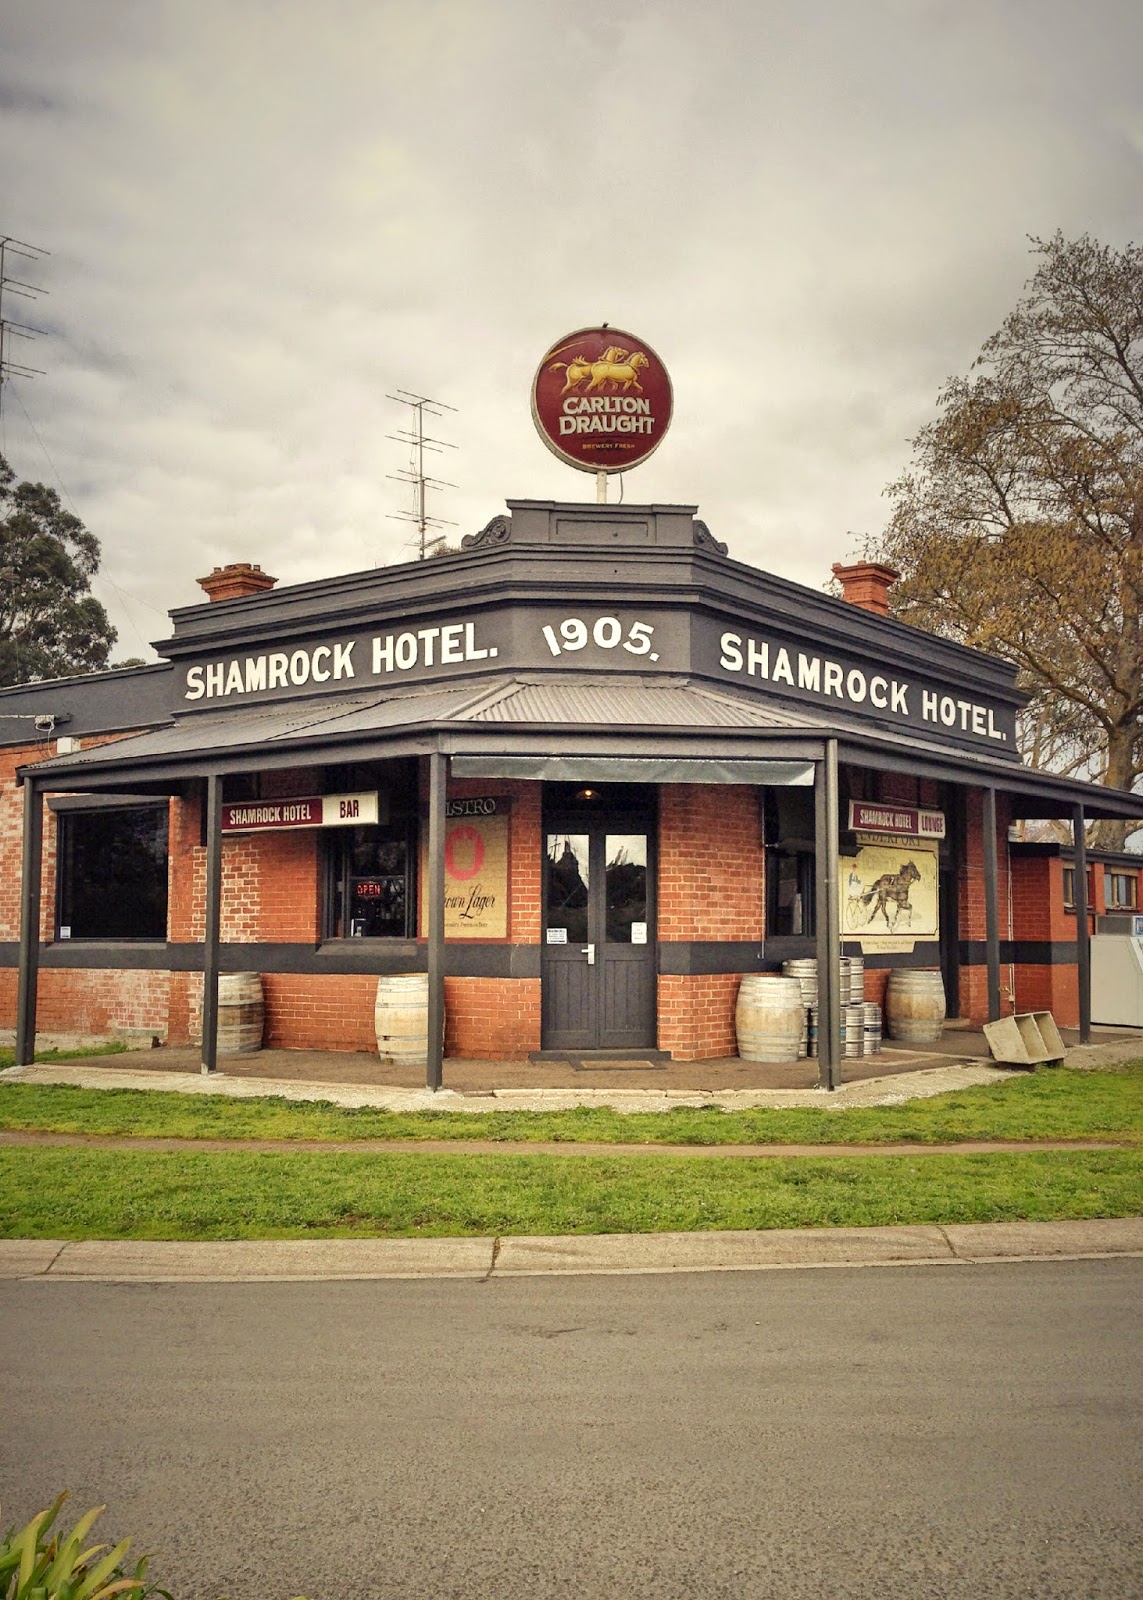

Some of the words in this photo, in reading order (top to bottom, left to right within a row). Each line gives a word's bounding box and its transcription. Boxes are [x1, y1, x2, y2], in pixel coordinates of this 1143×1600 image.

[562, 396, 651, 415] CARLTON
[559, 415, 655, 435] DRAUGHT
[184, 641, 356, 700] SHAMROCK
[372, 622, 498, 674] HOTEL.
[719, 631, 909, 716] SHAMROCK
[921, 689, 1007, 741] HOTEL.
[229, 806, 281, 825] SHAMROCK
[283, 804, 312, 822] HOTEL
[339, 799, 359, 819] BAR
[445, 798, 496, 816] ISTRO
[859, 808, 894, 827] SHAMROCK
[894, 813, 912, 829] HOTEL
[921, 815, 943, 833] LOUNGE
[356, 884, 381, 896] OPEN
[459, 883, 496, 919] Lager
